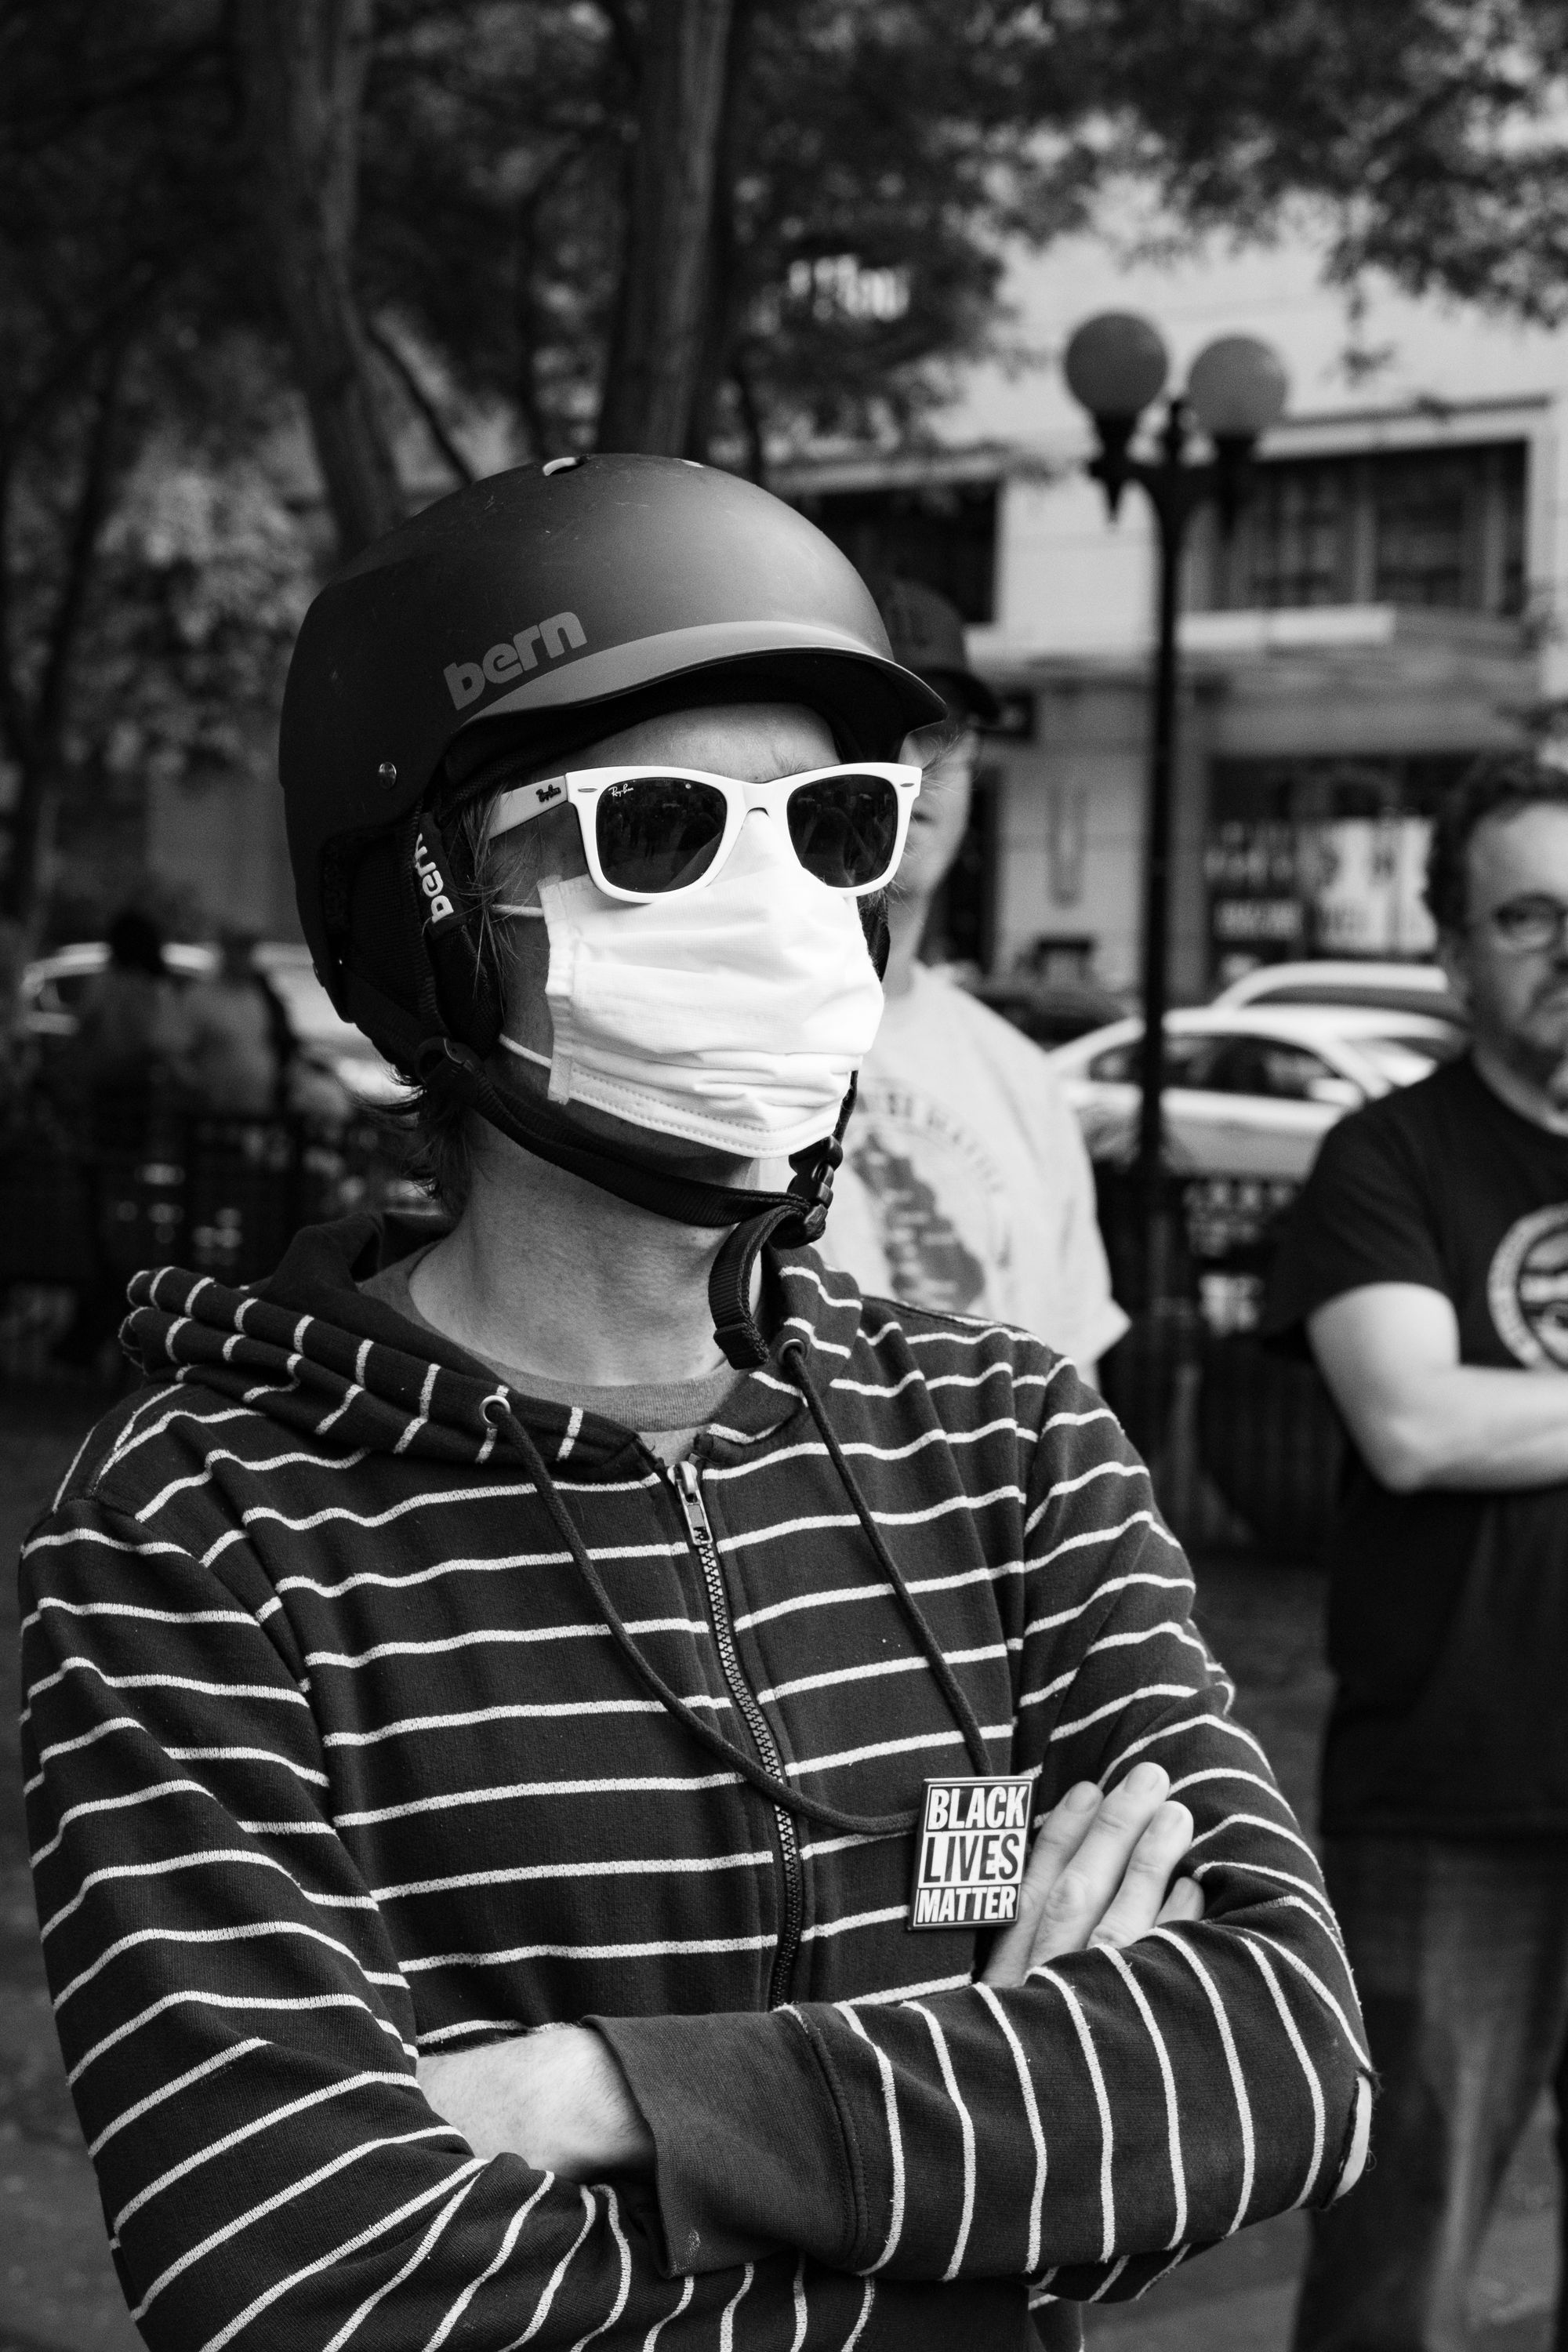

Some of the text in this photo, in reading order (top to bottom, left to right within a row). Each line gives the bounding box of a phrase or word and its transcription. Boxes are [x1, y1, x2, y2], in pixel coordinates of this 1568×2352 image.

[443, 612, 588, 711] bern
[608, 783, 634, 797] Ray-Ban
[927, 1786, 1028, 1830] BLACK
[923, 1833, 1020, 1883] LIVES
[917, 1885, 1017, 1923] MATTER
